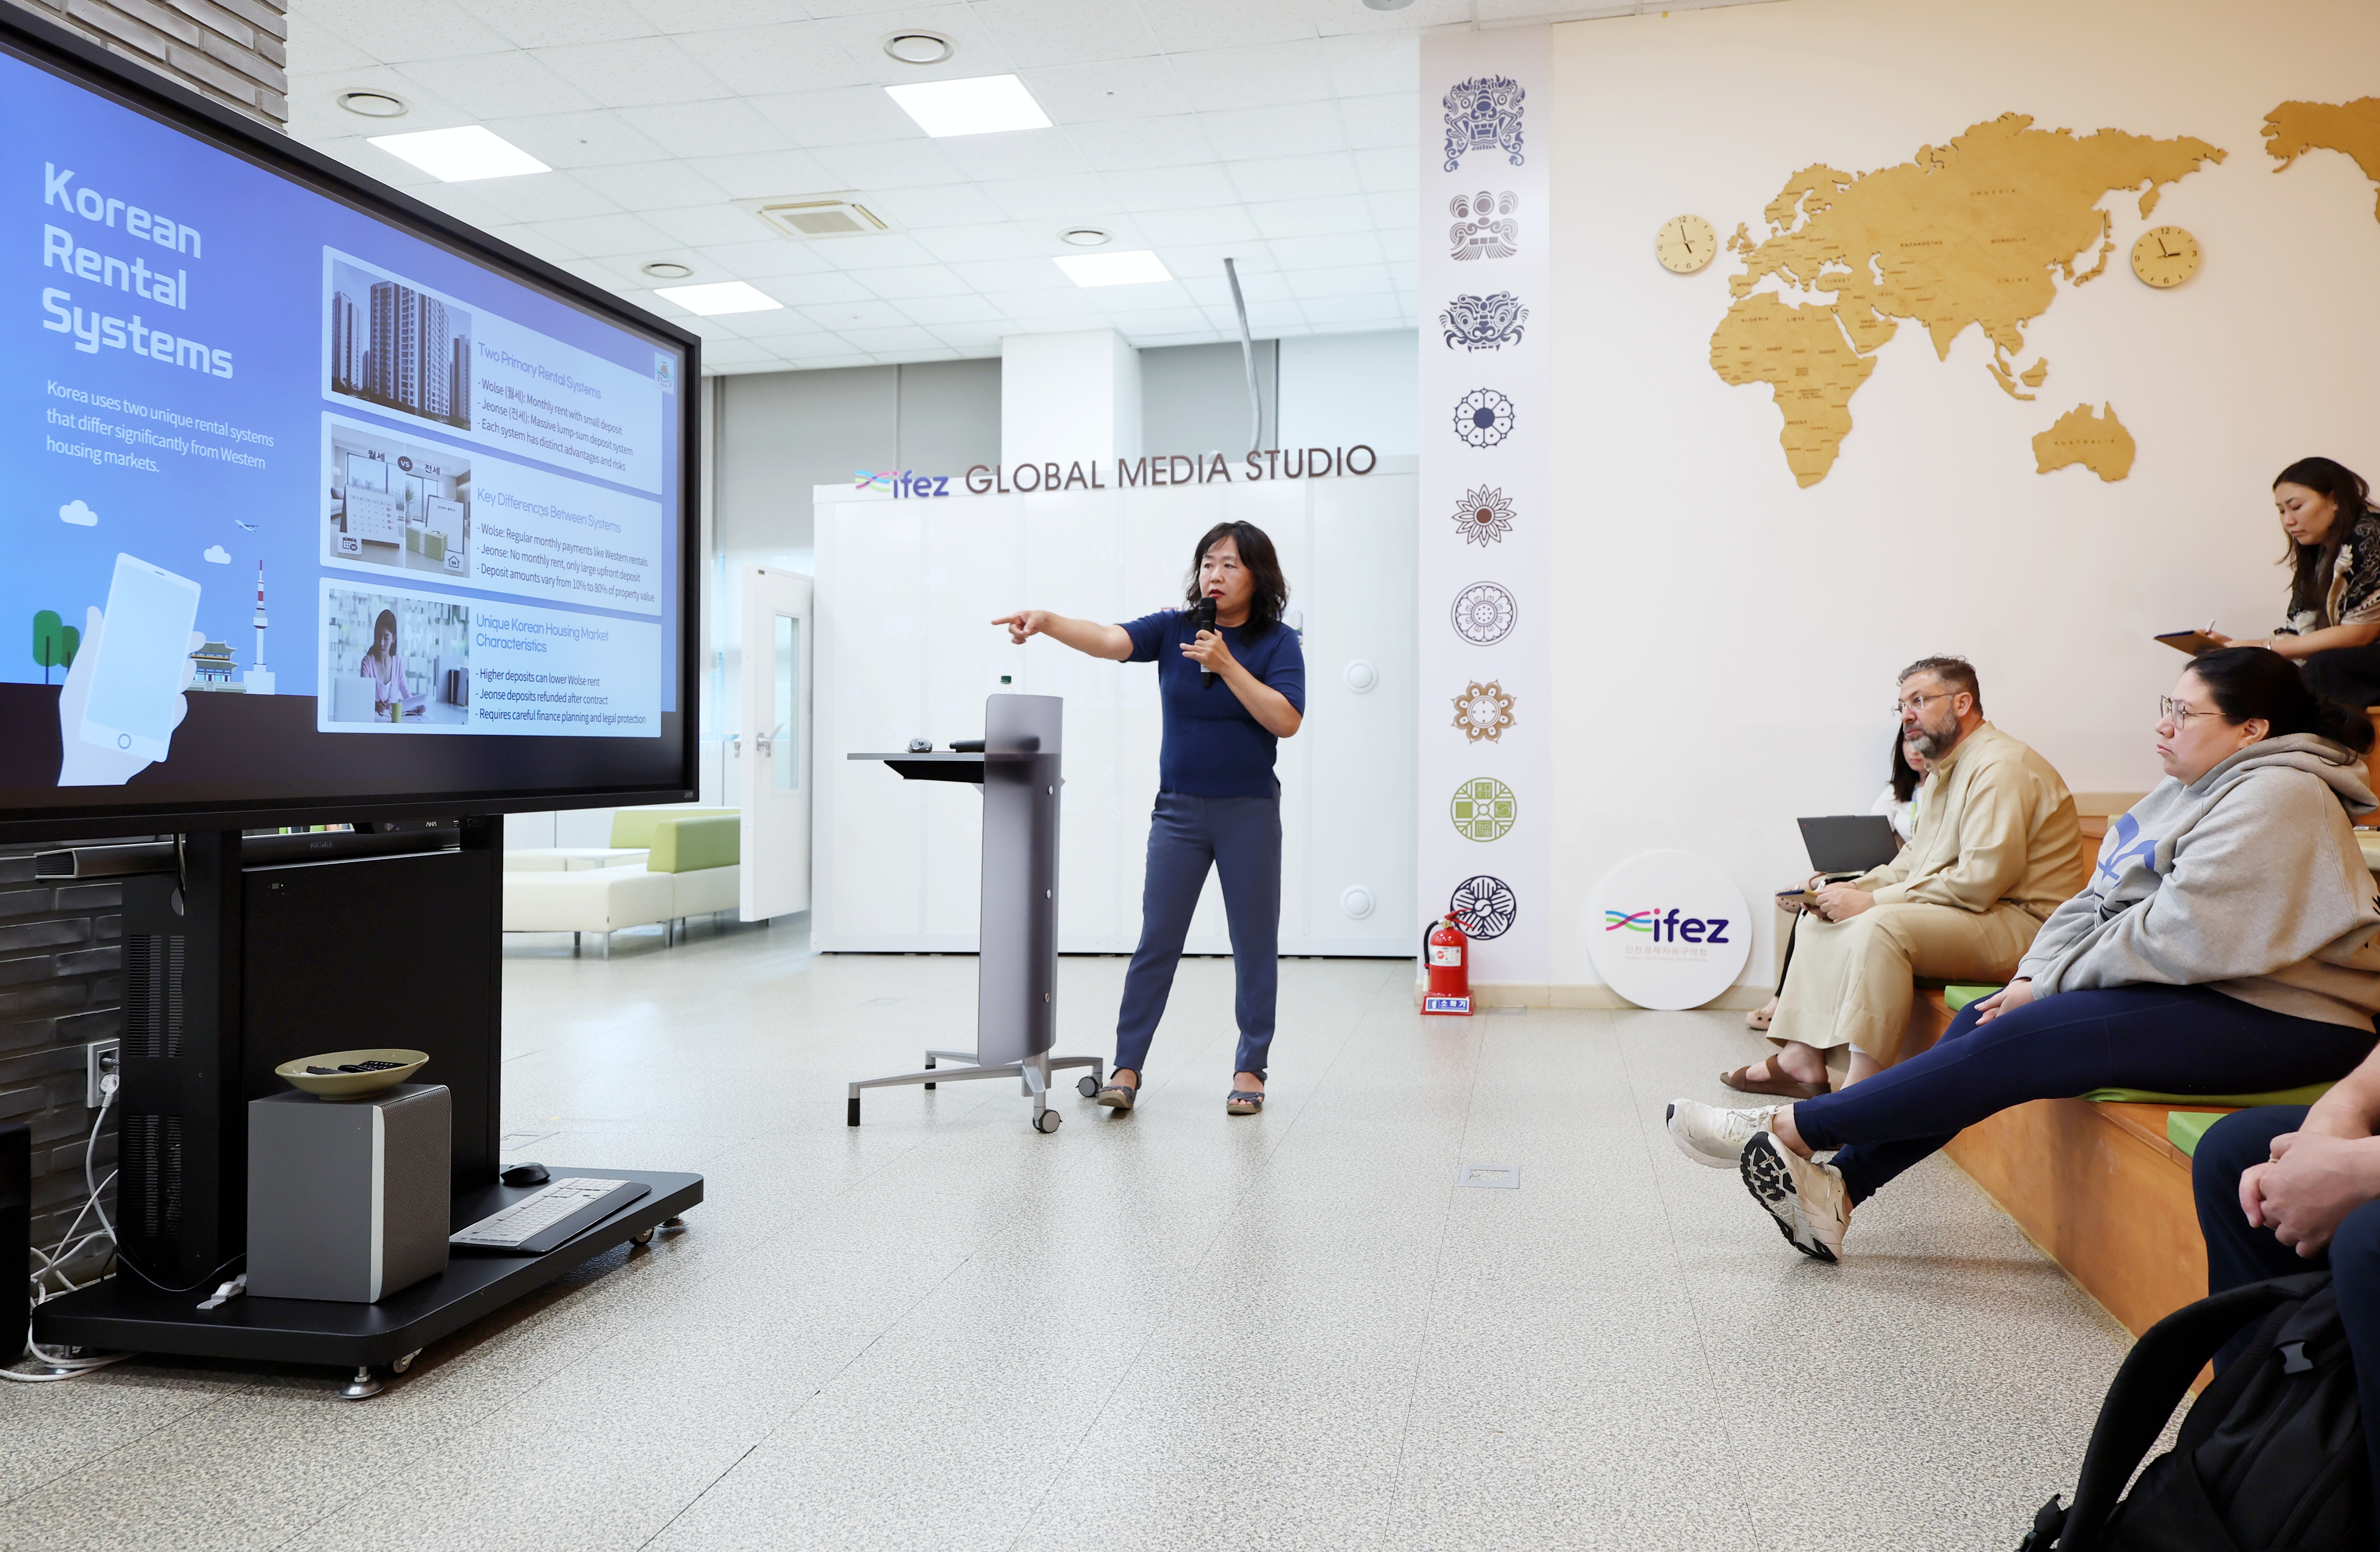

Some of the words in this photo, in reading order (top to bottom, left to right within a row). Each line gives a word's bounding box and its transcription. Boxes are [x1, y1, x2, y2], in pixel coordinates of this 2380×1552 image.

[45, 161, 201, 259] Korean
[44, 223, 186, 310] Rental
[43, 287, 233, 379] Systems
[478, 341, 499, 362] Two
[502, 351, 537, 379] Primary
[539, 365, 565, 387] Rental
[567, 376, 601, 399] Systems
[48, 380, 88, 403] Korea
[92, 394, 121, 411] uses
[123, 399, 147, 417] two
[151, 408, 193, 428] unique
[195, 419, 228, 436] rental
[230, 428, 274, 447] systems
[482, 378, 504, 395] Wolse
[506, 385, 525, 404] (월세):
[527, 394, 554, 414] Monthly
[555, 406, 568, 417] rent
[569, 410, 582, 422] with
[584, 416, 599, 428] small
[601, 419, 622, 436] deposit
[482, 399, 507, 416] Jeonse
[509, 407, 529, 424] (전세):
[531, 414, 556, 432] Massive
[558, 422, 589, 442] lump-sum
[590, 434, 612, 450] deposit
[613, 443, 633, 456] system
[47, 408, 76, 428] that
[78, 415, 114, 436] differ
[115, 424, 189, 456] significantly
[191, 439, 218, 459] from
[221, 447, 265, 469] Western
[47, 434, 102, 465] housing
[105, 451, 159, 472] markets.
[368, 450, 385, 462] 월세
[482, 418, 499, 433] Each
[501, 426, 525, 441] system
[527, 432, 538, 445] has
[540, 436, 563, 453] distinct
[565, 445, 599, 464] advantages
[601, 457, 611, 467] and
[613, 459, 625, 471] risks
[425, 464, 440, 476] 전세
[892, 470, 949, 498] ifez
[966, 463, 1105, 495] GLOBAL
[1119, 453, 1231, 488] MEDIA
[1246, 444, 1376, 481] STUDIO
[478, 487, 496, 507] Key
[551, 505, 586, 525] Between
[588, 514, 621, 533] Systems
[481, 544, 508, 558] Jeonse:
[510, 549, 520, 560] No
[522, 553, 549, 568] monthly
[551, 559, 565, 570] rent,
[567, 560, 580, 574] only
[581, 562, 595, 576] large
[597, 566, 619, 579] upfront
[620, 570, 640, 583] deposit
[482, 523, 504, 538] Wolse:
[507, 528, 532, 544] Regular
[534, 536, 561, 552] monthly
[562, 542, 592, 556] payments
[594, 546, 604, 558] like
[605, 549, 628, 563] Western
[629, 556, 647, 567] rentals
[482, 564, 508, 578] Deposit
[510, 570, 540, 583] amounts
[542, 576, 555, 588] vary
[556, 576, 571, 588] from
[573, 579, 586, 591] 10%
[588, 582, 594, 592] to
[595, 583, 607, 594] 80%
[609, 585, 615, 595] of
[615, 589, 639, 602] property
[640, 592, 654, 602] value
[476, 633, 546, 653] Characteristics
[477, 613, 510, 632] Unique
[512, 618, 544, 634] Korean
[546, 623, 579, 641] Housing
[582, 627, 609, 642] Market
[480, 668, 504, 683] Higher
[506, 669, 534, 683] deposits
[549, 673, 567, 684] lower
[568, 675, 586, 686] Wolse
[588, 678, 599, 687] rent
[480, 689, 505, 700] Jeonse
[507, 689, 536, 703] deposits
[538, 691, 566, 703] refunded
[568, 693, 582, 703] after
[584, 695, 608, 705] contract
[480, 708, 511, 722] Requires
[512, 709, 535, 720] careful
[537, 709, 560, 721] finance
[562, 711, 589, 725] planning
[590, 713, 601, 722] and
[603, 713, 616, 725] legal
[617, 715, 645, 725] protection
[1653, 908, 1730, 944] ifez
